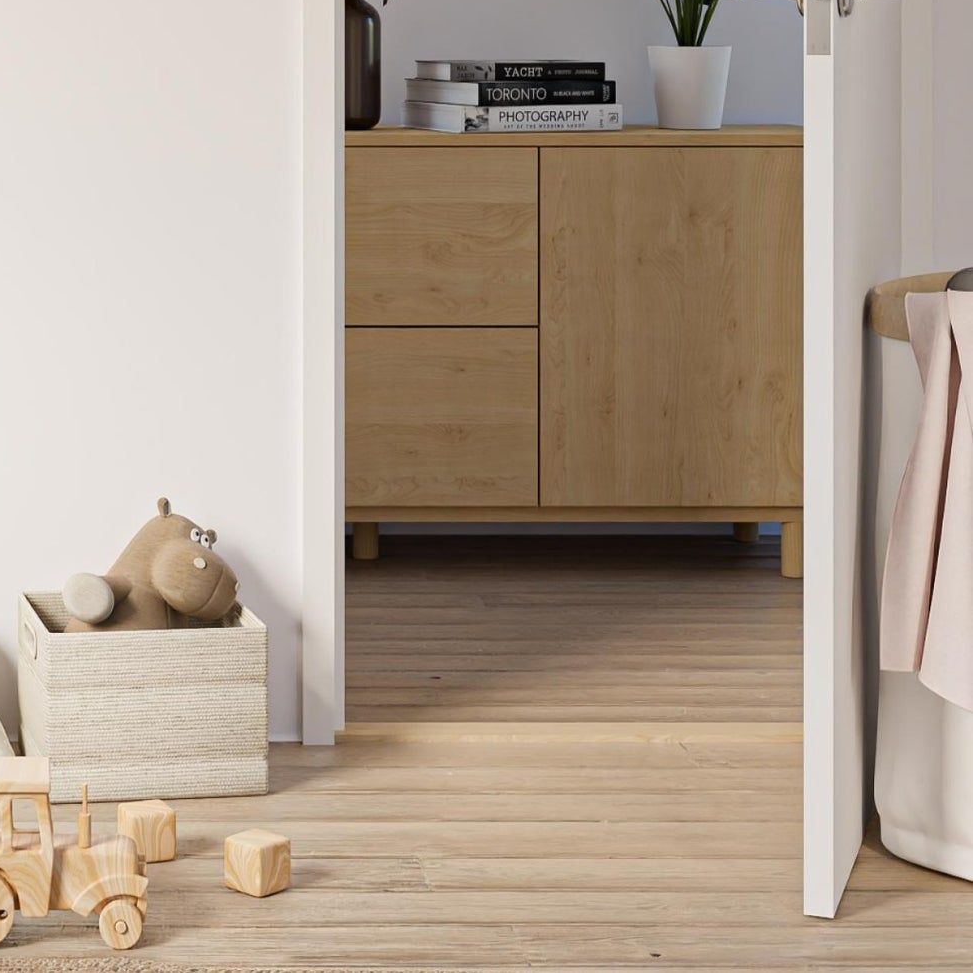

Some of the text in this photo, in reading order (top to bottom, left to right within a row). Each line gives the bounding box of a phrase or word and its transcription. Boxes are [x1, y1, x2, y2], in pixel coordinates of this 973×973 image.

[503, 67, 543, 77] YACHT
[486, 87, 547, 101] TORONTO
[499, 110, 589, 122] PHOTOGRAPHY
